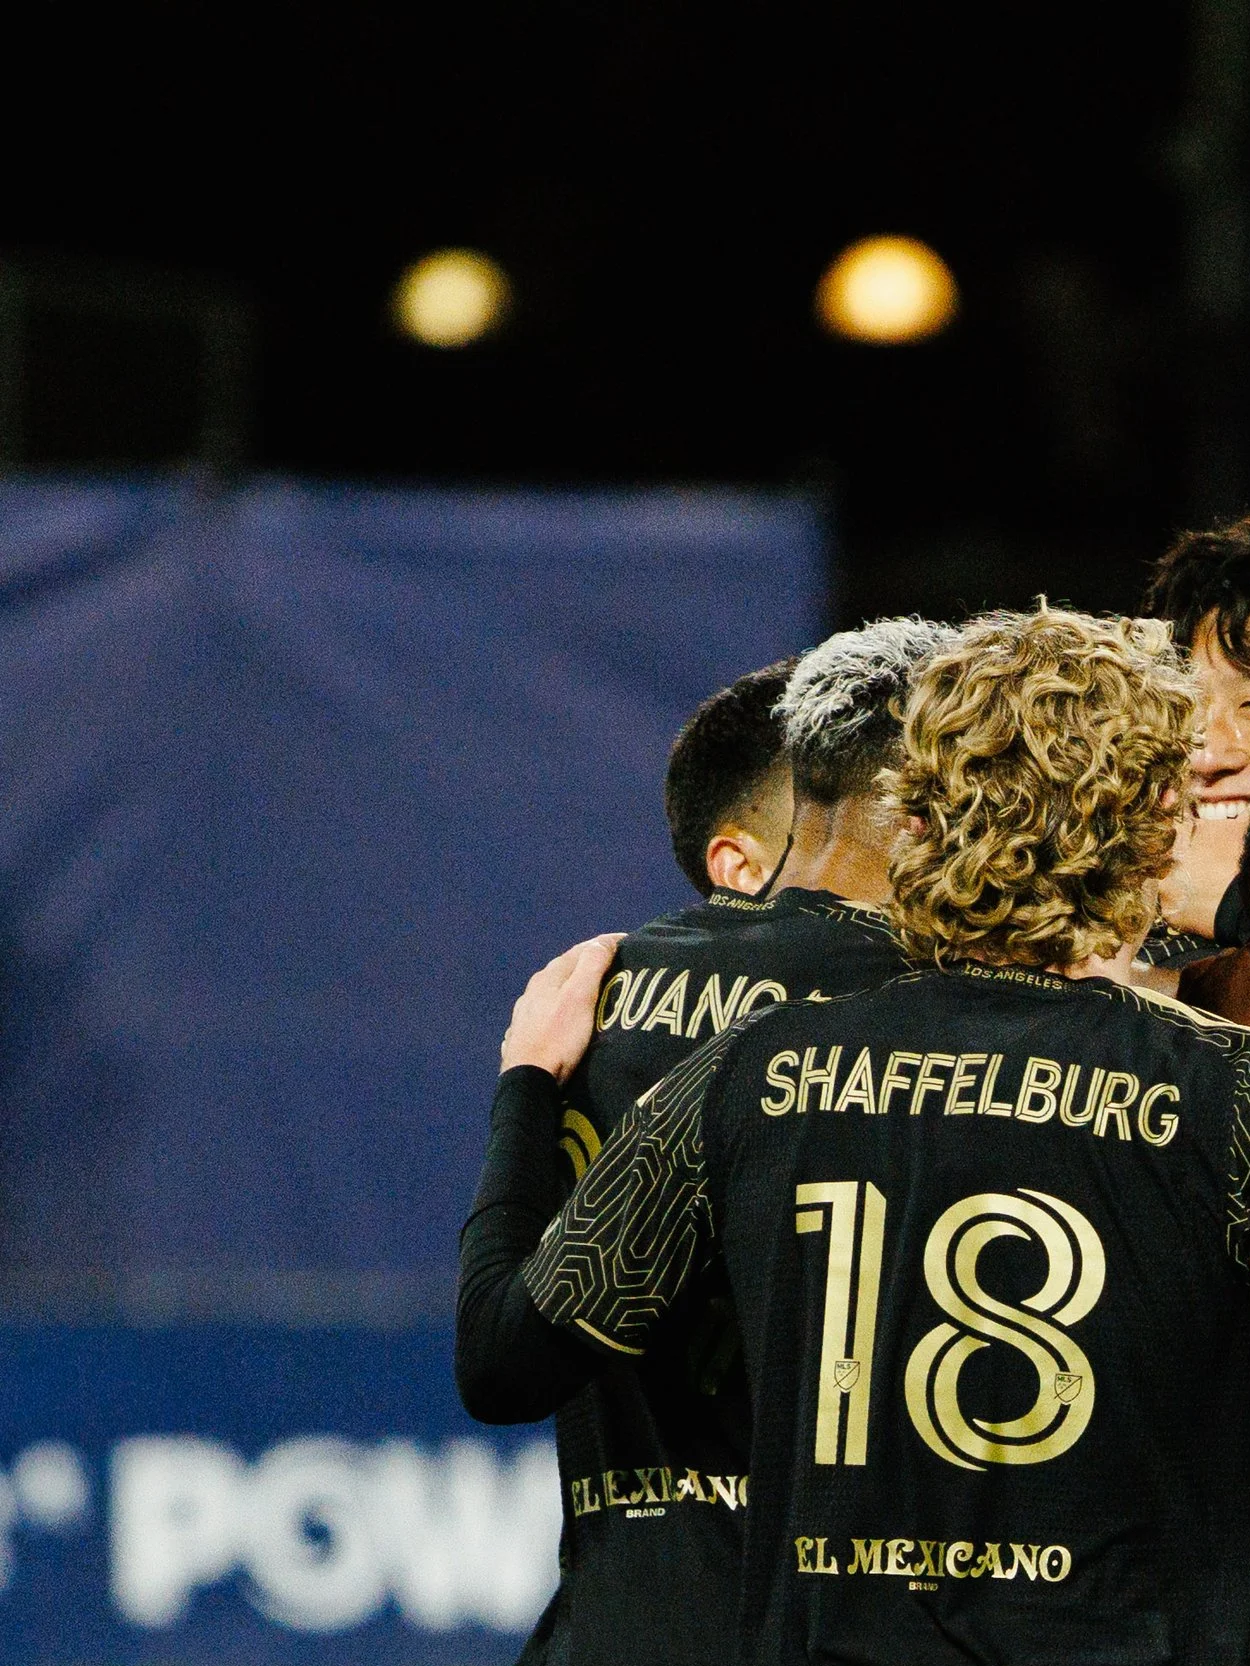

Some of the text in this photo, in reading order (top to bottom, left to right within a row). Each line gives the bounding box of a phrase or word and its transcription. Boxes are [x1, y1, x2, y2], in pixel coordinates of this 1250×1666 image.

[963, 962, 1063, 990] LOS ANGELES
[760, 1046, 1180, 1147] SHAFFELBURG
[795, 1180, 1106, 1472] 18
[626, 1507, 666, 1518] BRAND
[795, 1536, 1072, 1583] EL MEXICANO
[908, 1581, 938, 1592] BRAND
